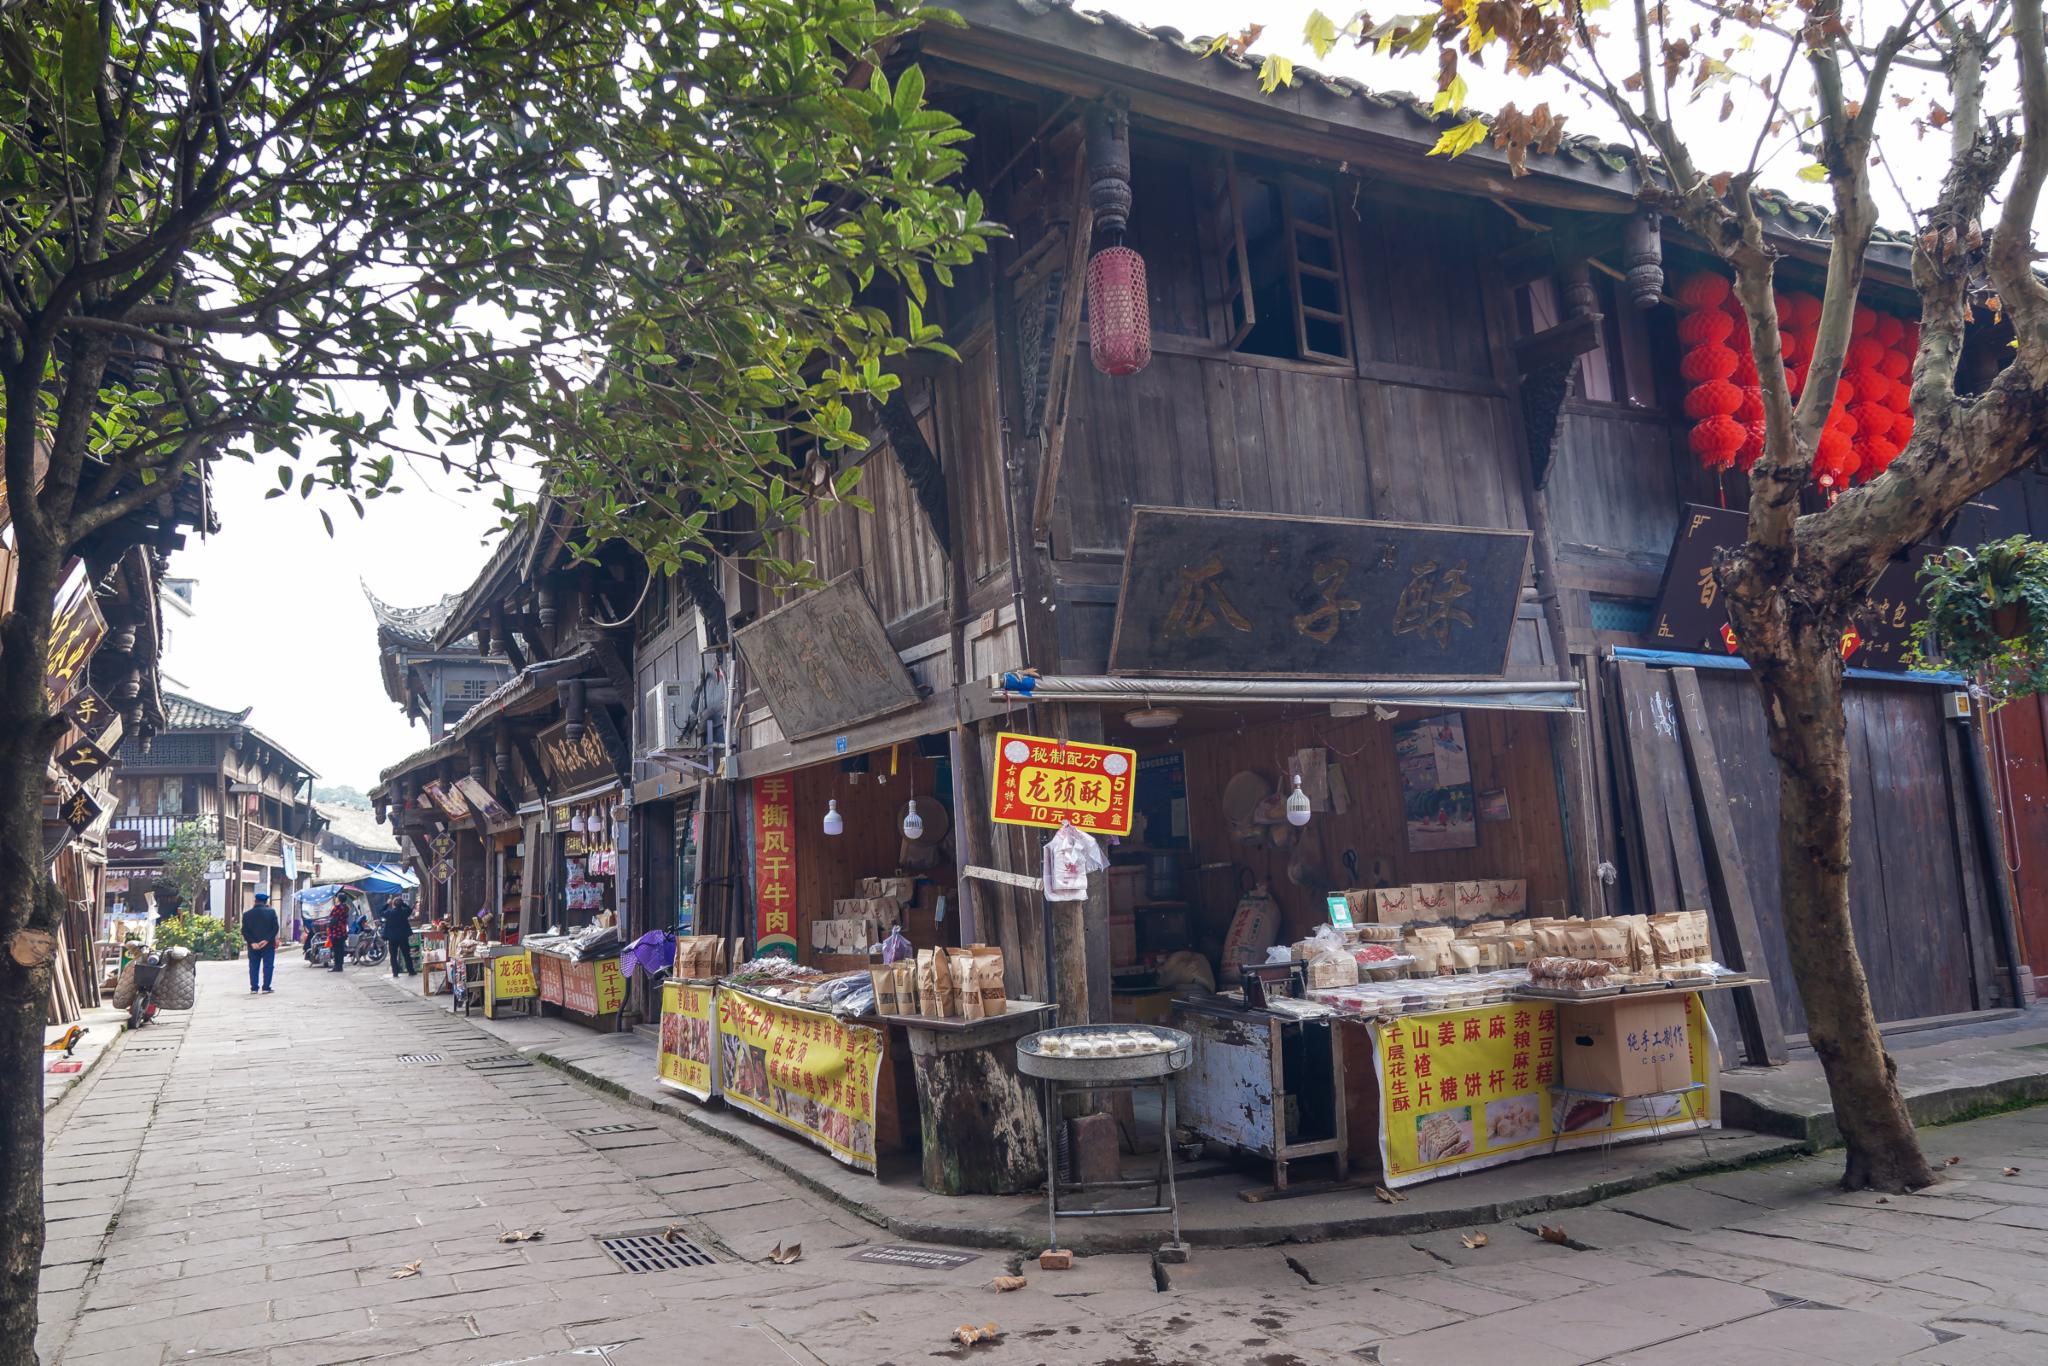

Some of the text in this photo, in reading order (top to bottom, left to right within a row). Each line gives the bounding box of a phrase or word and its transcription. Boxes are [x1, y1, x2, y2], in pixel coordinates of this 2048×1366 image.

[1162, 552, 1476, 652] 瓜子酥
[1002, 763, 1018, 814] 古镇特产
[1026, 769, 1107, 807] 龙须酥
[1030, 745, 1102, 769] 秘制配方
[1029, 806, 1098, 827] 10元3盒
[1110, 776, 1126, 826] 5元一盒
[761, 778, 790, 933] 手撕风干牛肉
[601, 961, 622, 1011] 风干牛肉
[1387, 1027, 1412, 1113] 千层花生酥
[1412, 1025, 1433, 1108] 山楂片
[1437, 1020, 1459, 1103] 姜糖
[1463, 1017, 1482, 1098] 麻饼
[1488, 1014, 1507, 1093] 麻杆
[1511, 1010, 1531, 1091] 杂粮麻花
[1535, 1009, 1555, 1086] 绿豆糕
[1626, 1024, 1684, 1053] 纯手工制作
